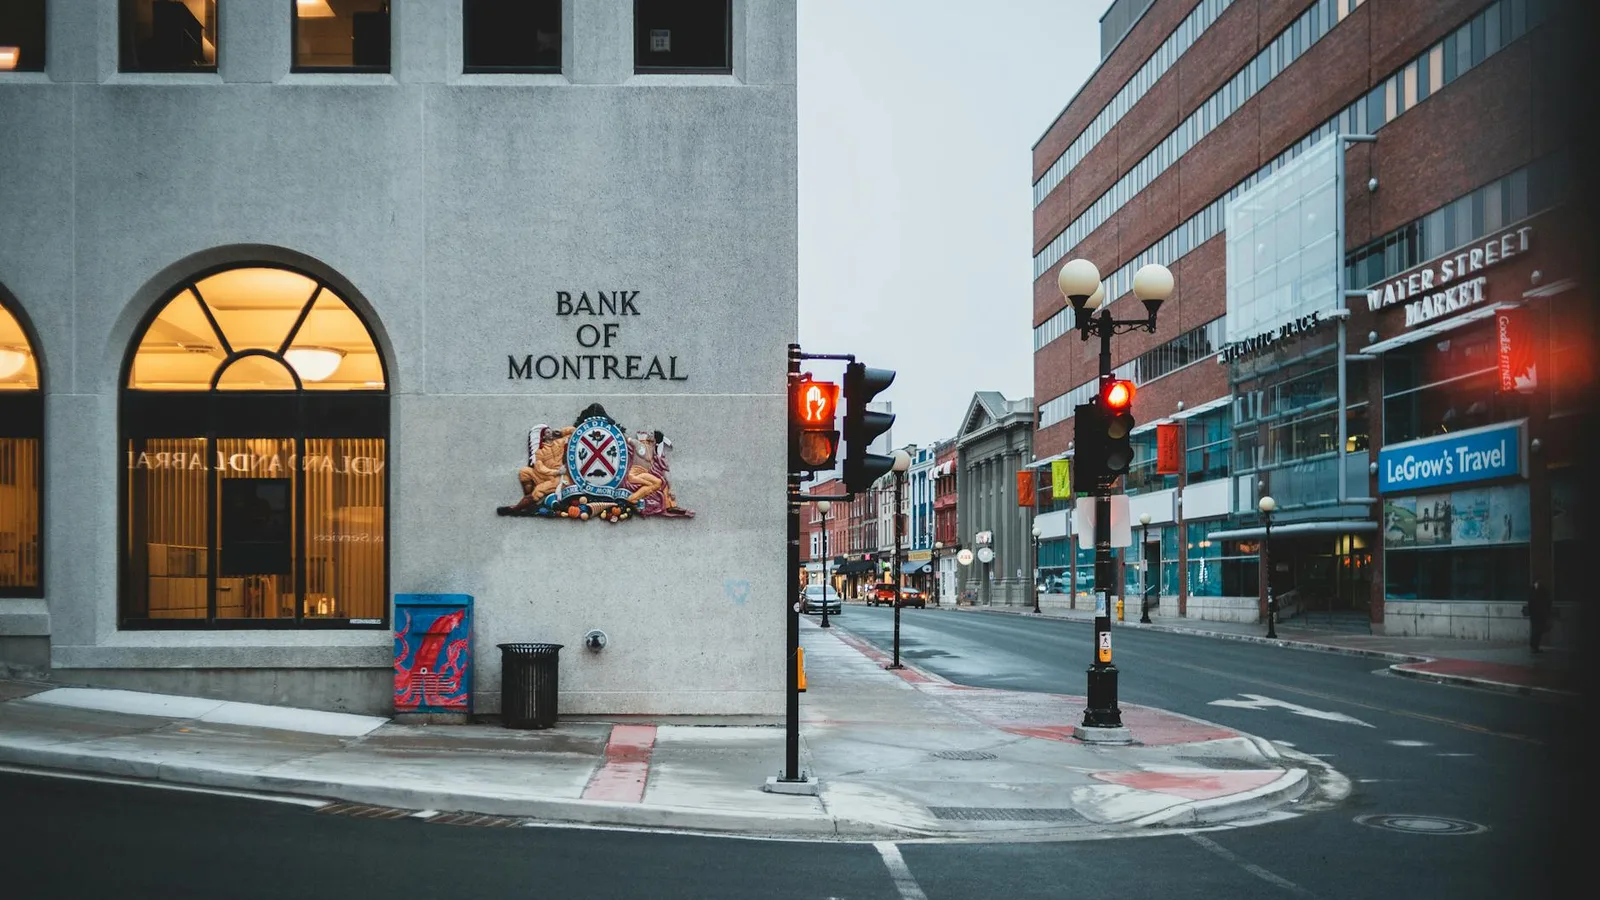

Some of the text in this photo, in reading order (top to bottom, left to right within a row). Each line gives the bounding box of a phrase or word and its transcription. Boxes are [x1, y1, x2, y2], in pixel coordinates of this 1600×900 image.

[1367, 226, 1533, 312] WATER STREET
[556, 291, 641, 316] BANK
[1405, 276, 1487, 328] MARKET
[576, 323, 620, 347] OF
[1217, 310, 1320, 365] ATLANTIC PLACE
[508, 354, 689, 380] MONTREAL
[1501, 355, 1511, 391] FITNESS
[569, 421, 626, 470] CONCORDIA SALUS
[1387, 439, 1506, 484] LeGrow's Travel
